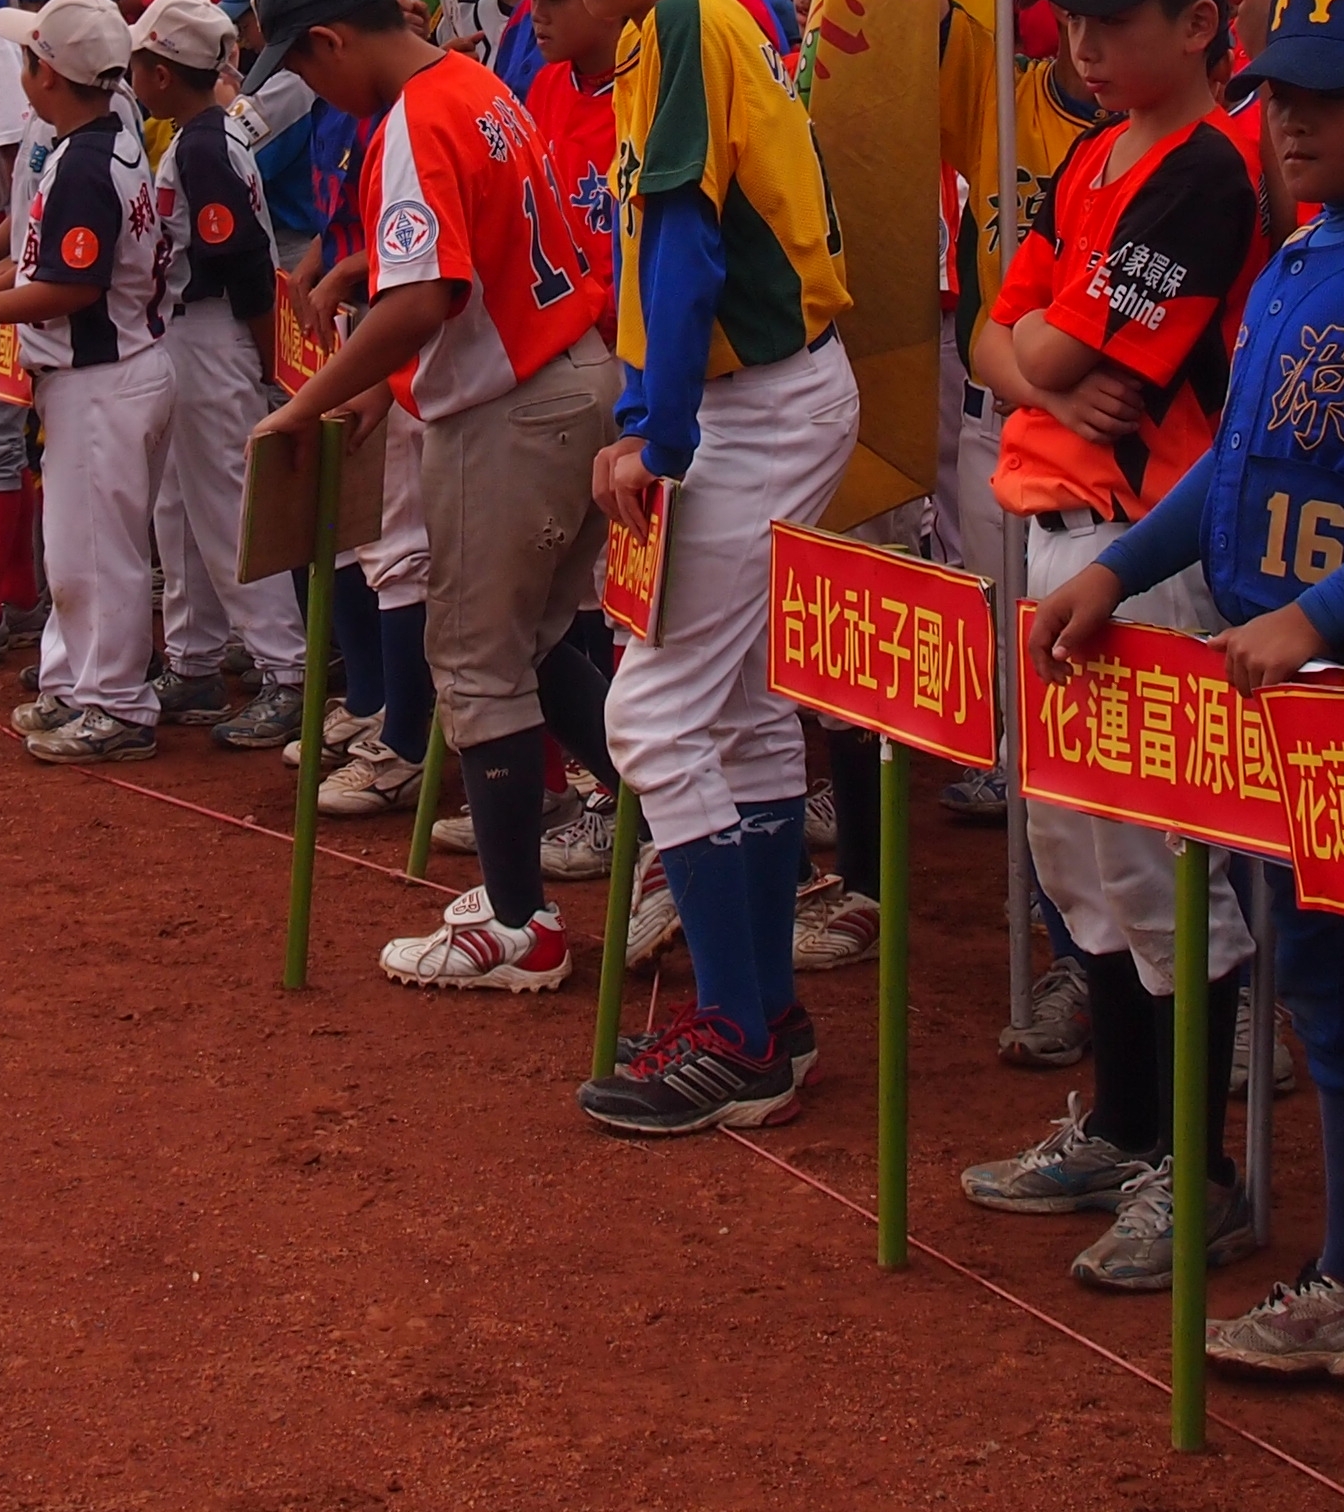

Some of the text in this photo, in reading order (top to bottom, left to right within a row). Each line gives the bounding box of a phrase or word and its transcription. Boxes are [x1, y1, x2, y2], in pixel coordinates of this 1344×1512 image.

[1085, 265, 1167, 331] E-shine
[782, 567, 985, 726] 台北社子國小
